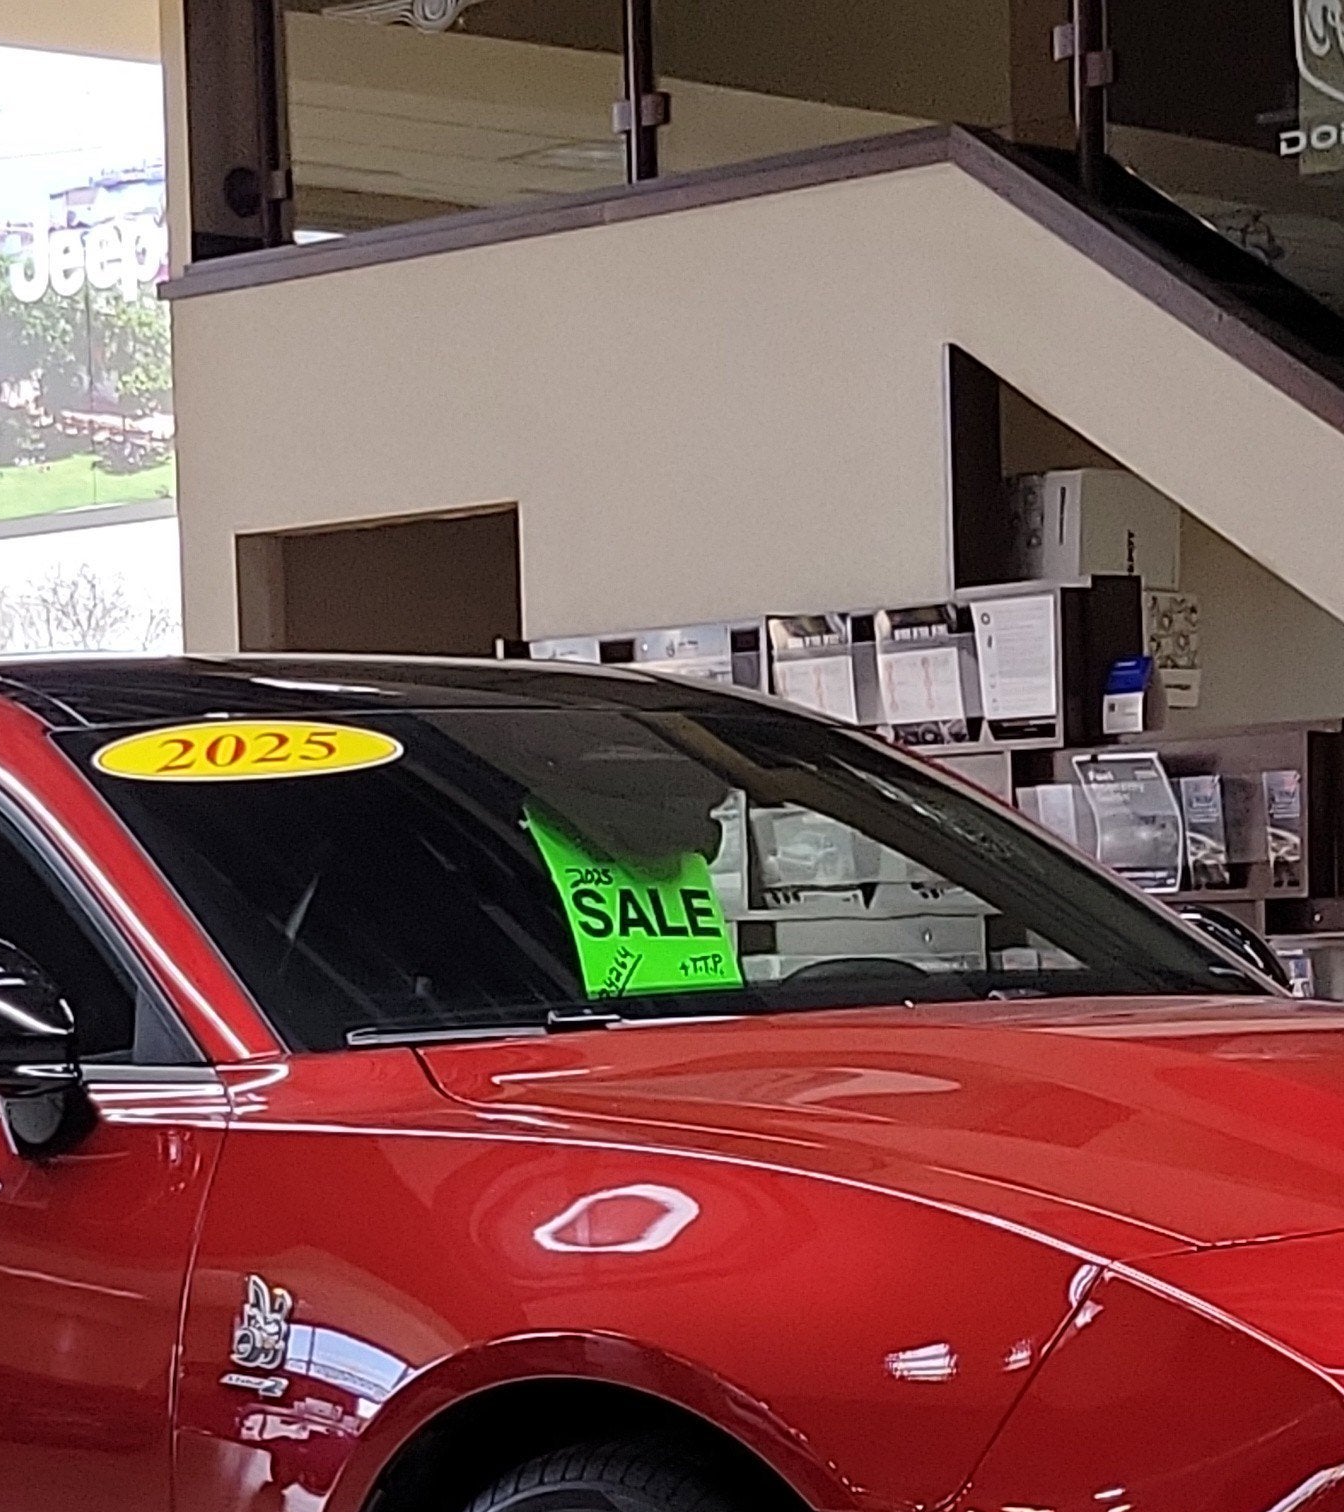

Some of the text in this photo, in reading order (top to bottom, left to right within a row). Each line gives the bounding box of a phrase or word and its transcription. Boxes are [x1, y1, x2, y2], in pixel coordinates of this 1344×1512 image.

[9, 208, 161, 304] Jeep
[155, 731, 338, 773] 2025
[565, 867, 614, 889] 2025
[571, 887, 723, 938] SALE
